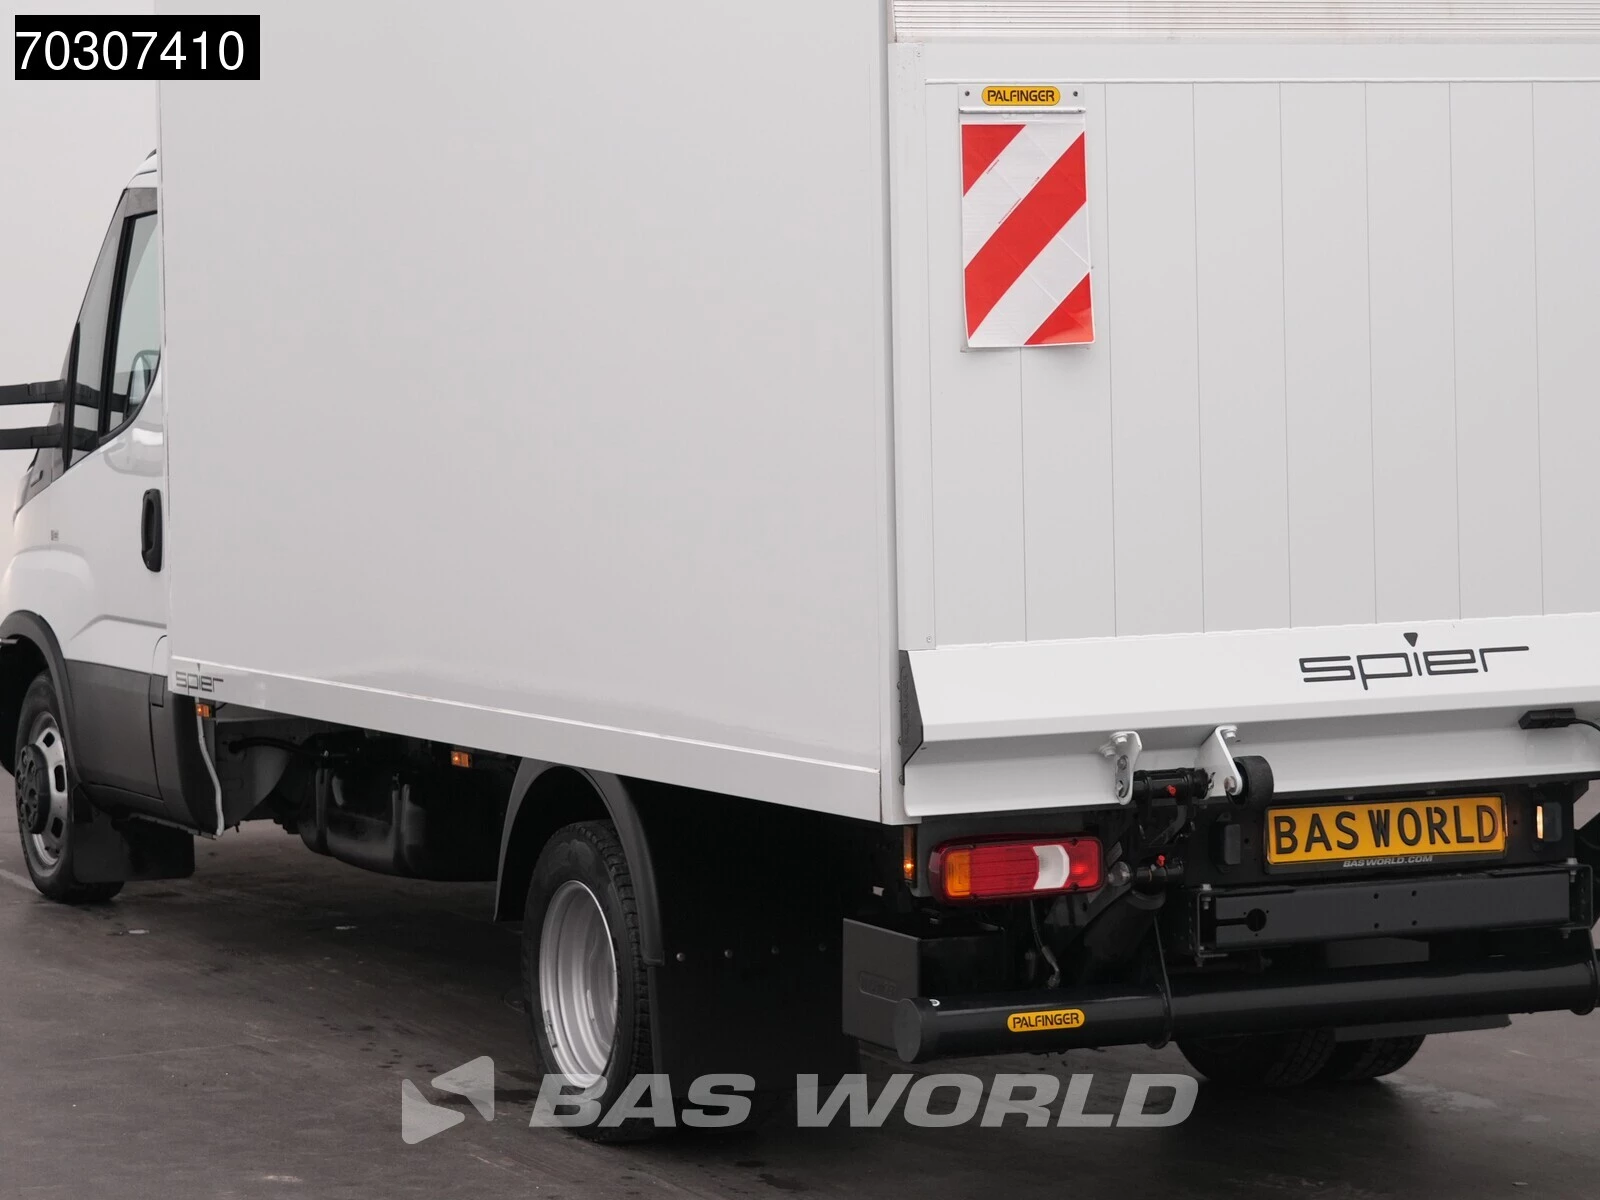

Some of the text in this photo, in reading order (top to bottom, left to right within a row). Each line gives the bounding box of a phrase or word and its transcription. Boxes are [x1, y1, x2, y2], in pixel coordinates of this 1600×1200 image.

[987, 89, 1055, 102] PALFINGER
[1299, 632, 1530, 690] spier
[1273, 804, 1499, 855] BAS WORLD
[1012, 1012, 1080, 1029] PALFINGER
